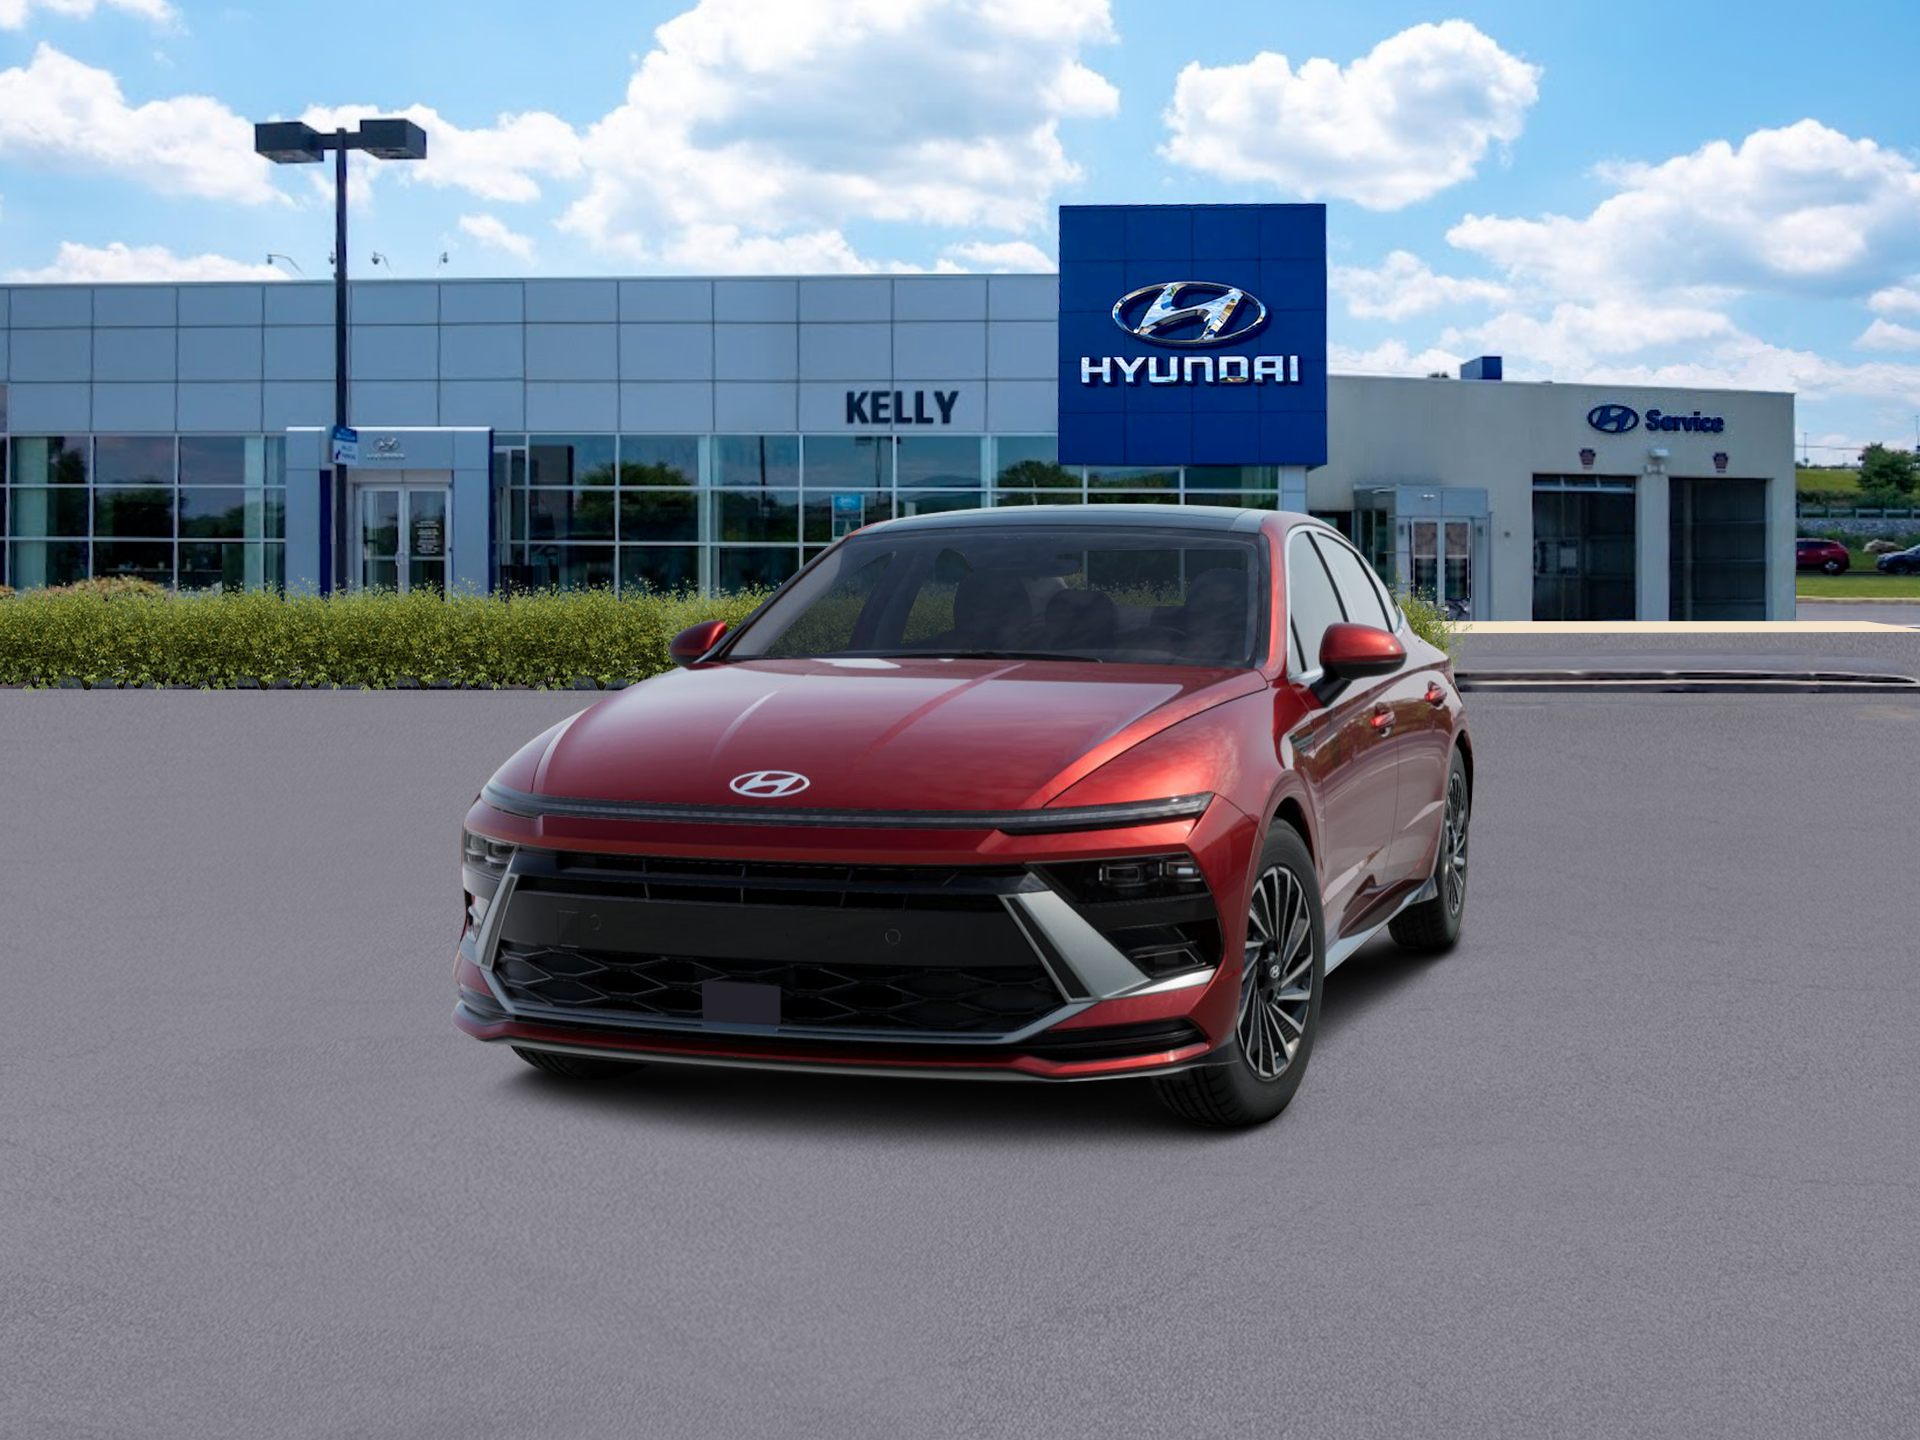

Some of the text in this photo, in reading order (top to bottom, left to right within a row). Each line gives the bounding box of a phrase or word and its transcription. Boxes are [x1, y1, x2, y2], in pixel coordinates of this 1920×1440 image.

[1081, 355, 1299, 384] HYUNDAI
[846, 390, 959, 424] KELLY
[1645, 409, 1724, 433] Service
